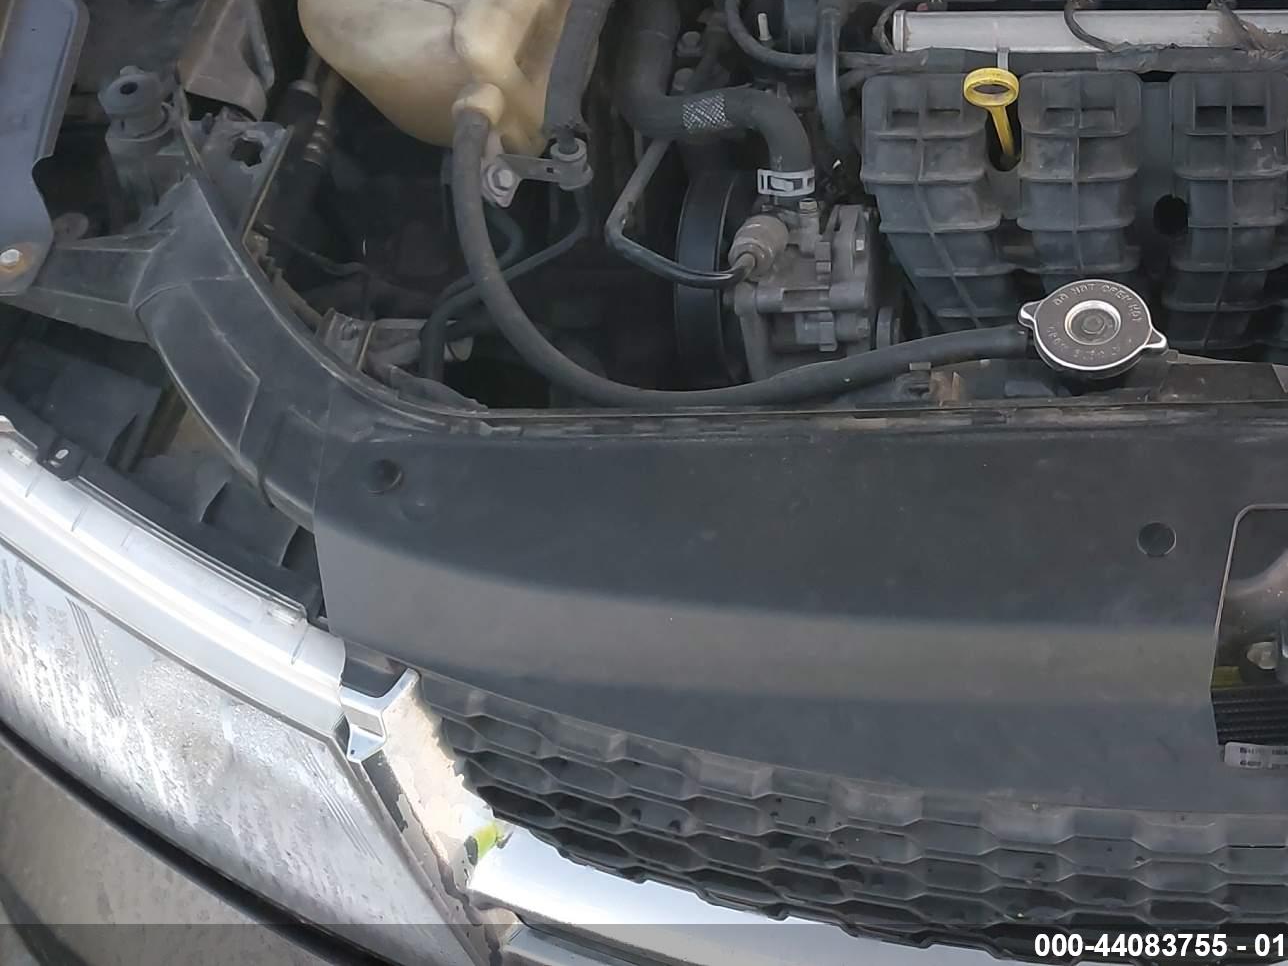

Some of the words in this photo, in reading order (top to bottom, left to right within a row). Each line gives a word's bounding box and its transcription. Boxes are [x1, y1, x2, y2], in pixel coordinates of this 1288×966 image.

[1054, 293, 1069, 306] DO
[1072, 283, 1096, 296] NOT
[1101, 284, 1133, 301] OPEN
